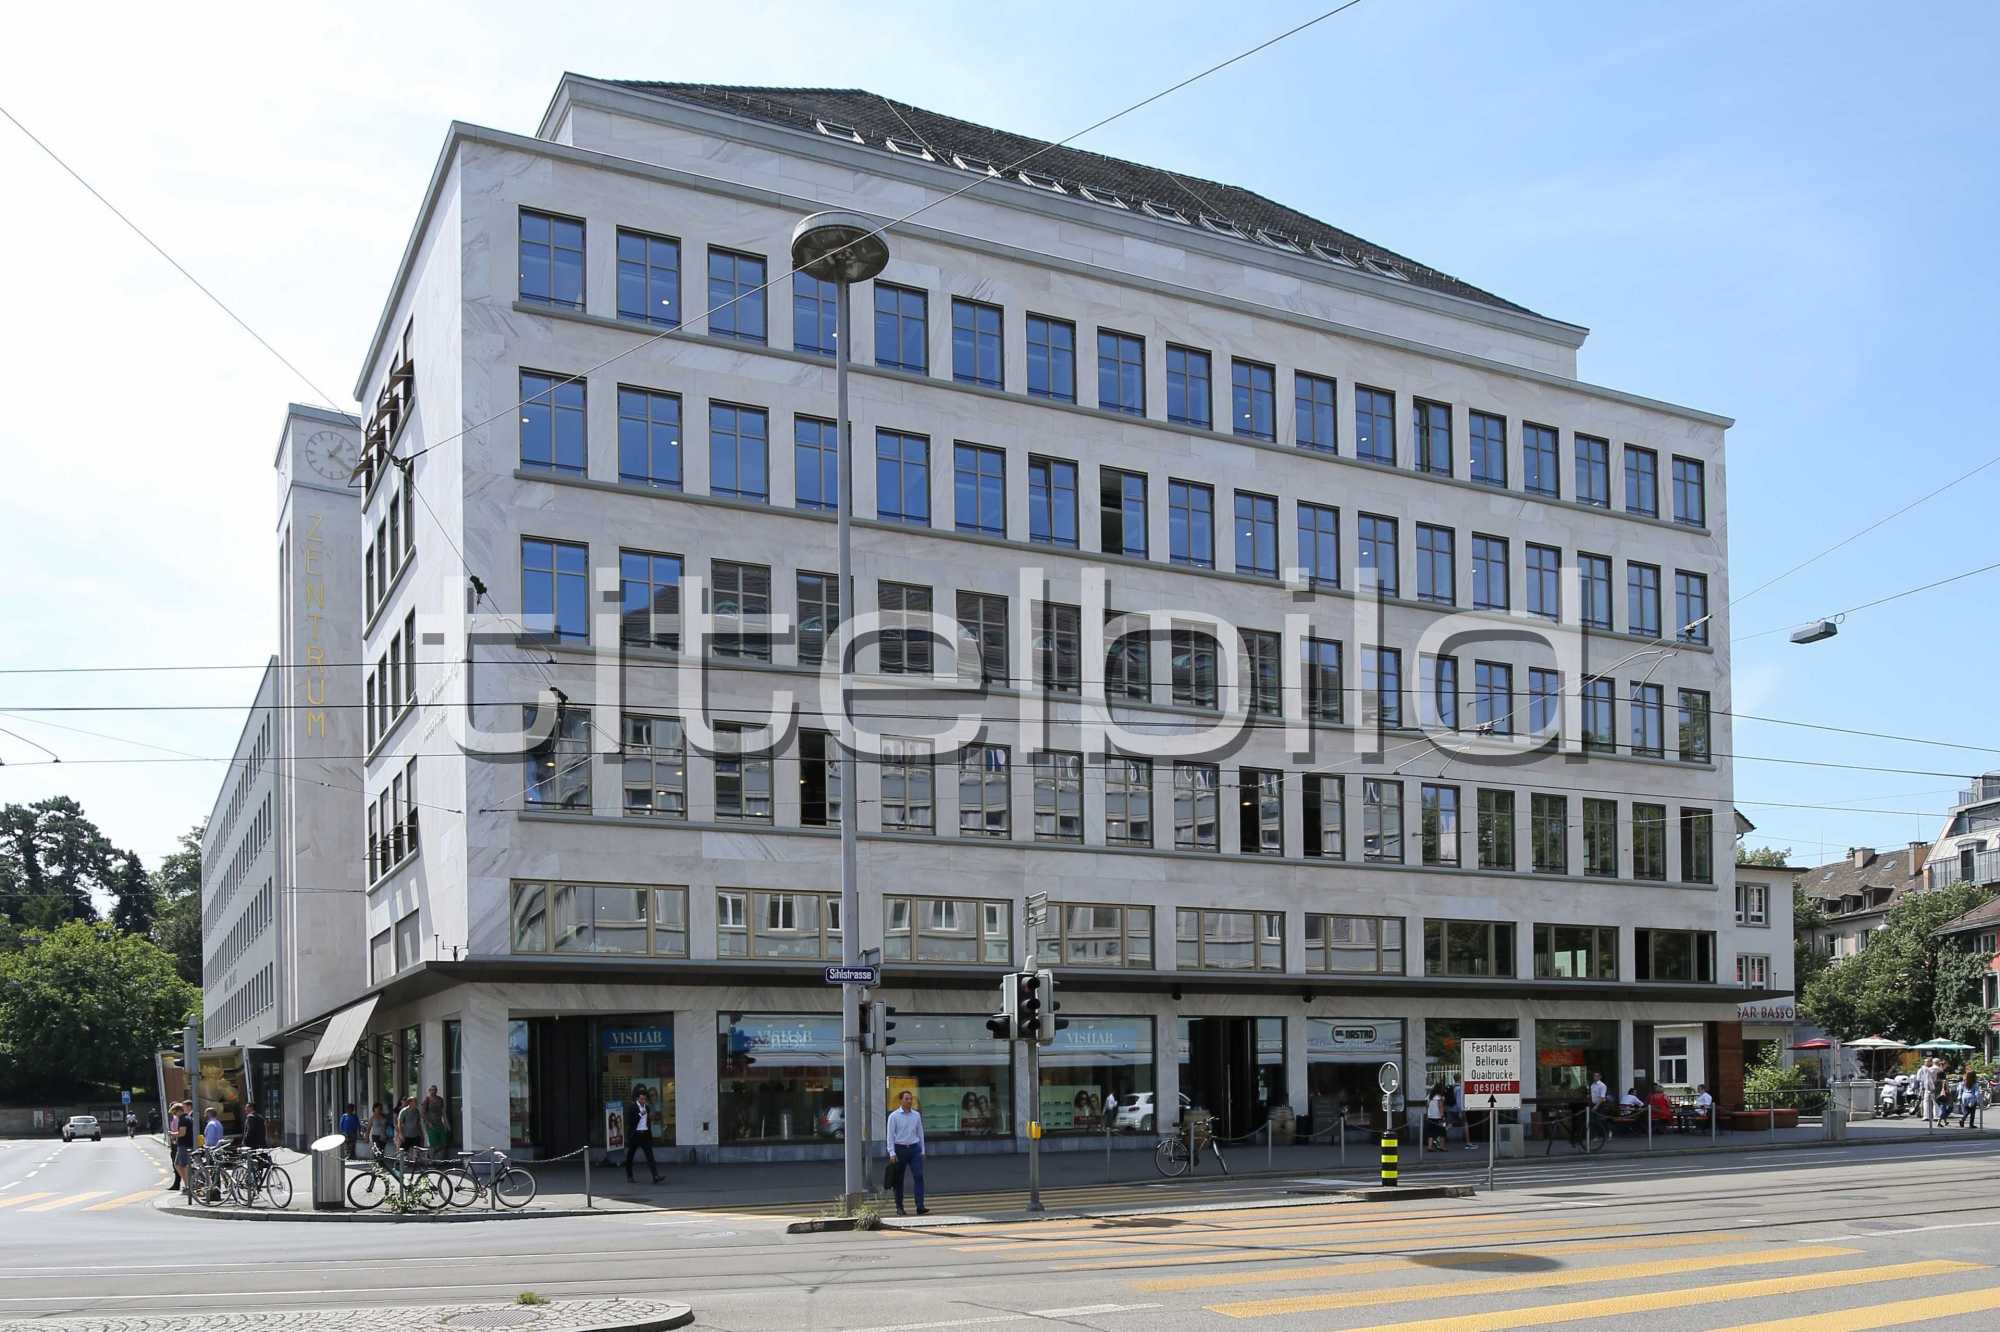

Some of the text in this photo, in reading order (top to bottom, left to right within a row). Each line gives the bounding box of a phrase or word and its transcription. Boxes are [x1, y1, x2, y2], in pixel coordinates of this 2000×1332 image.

[304, 511, 326, 738] ZENTRUM
[829, 968, 872, 980] Sihlstrasse
[1471, 1042, 1512, 1053] Festanlass
[1475, 1055, 1509, 1066] Bellevue
[1473, 1082, 1511, 1094] gesperrt
